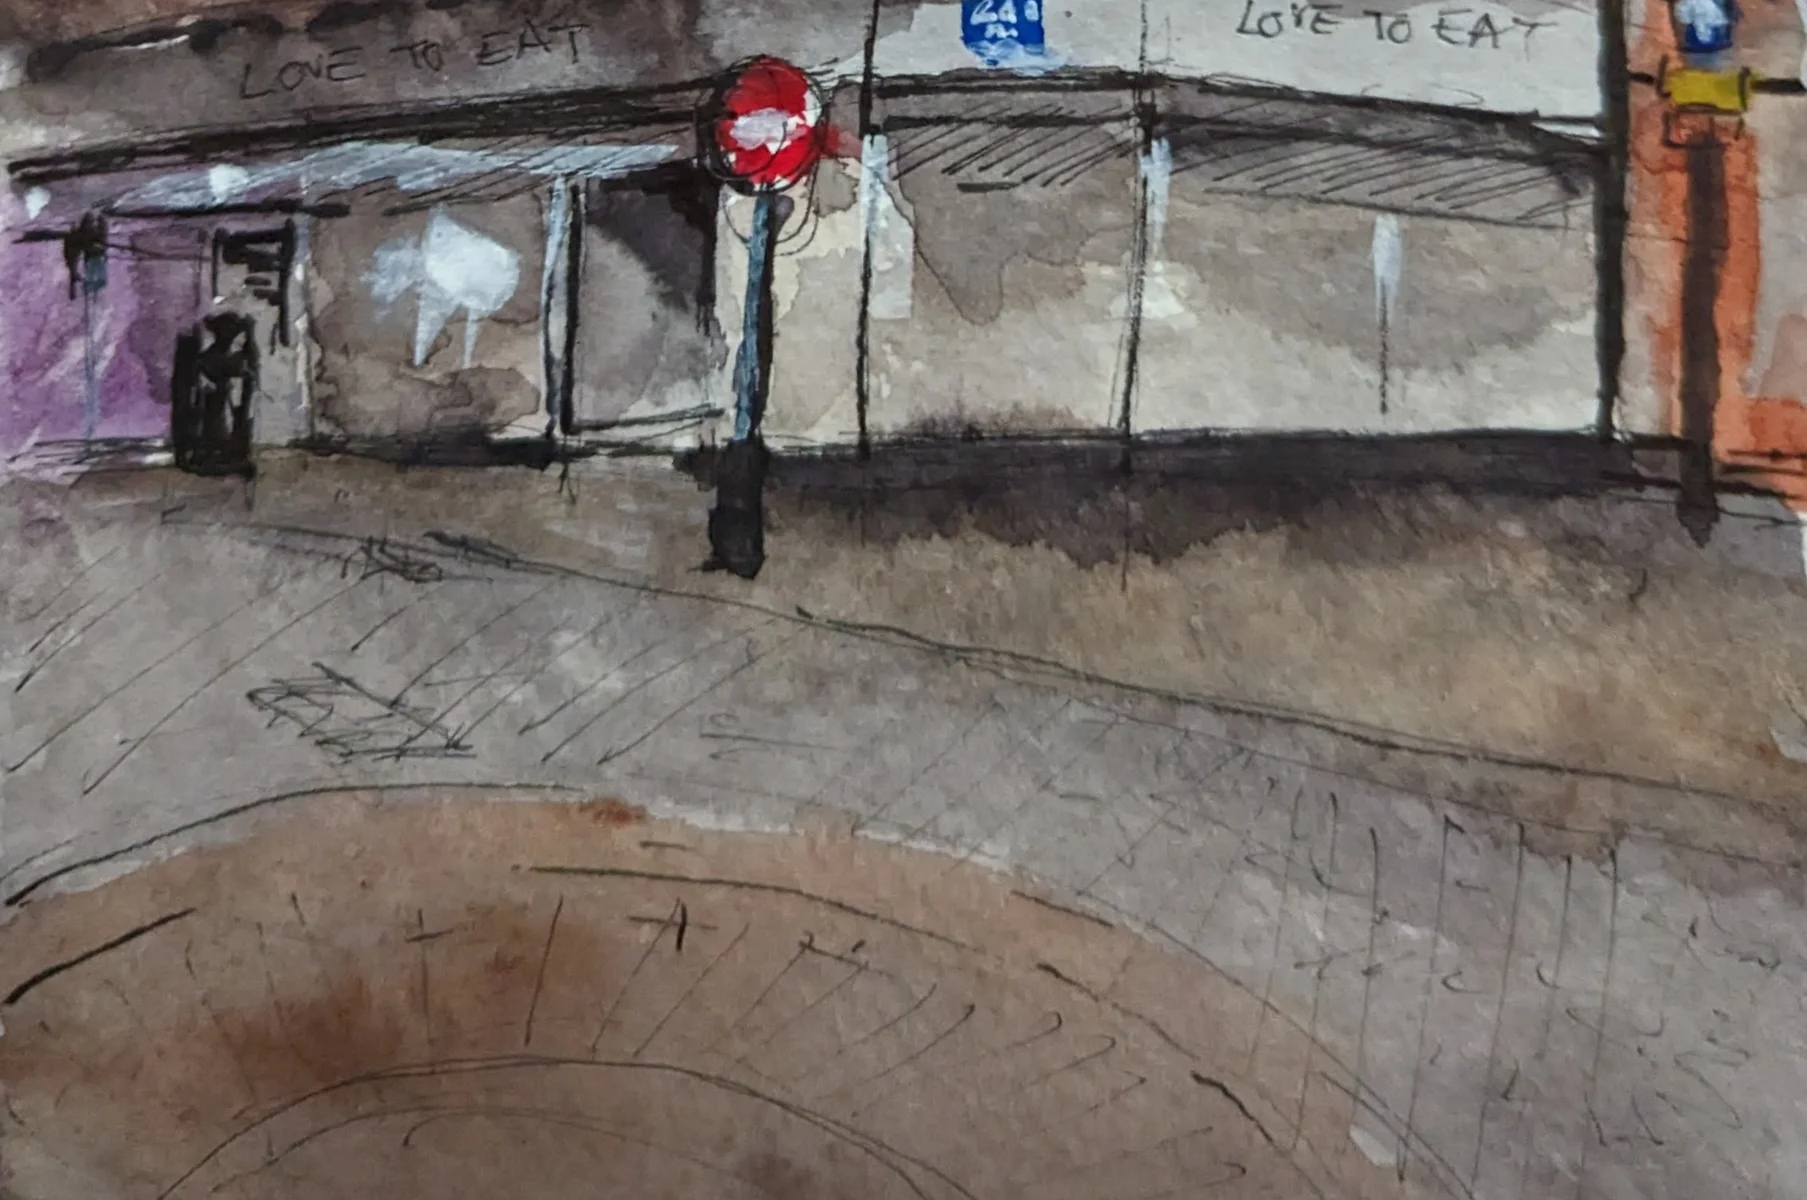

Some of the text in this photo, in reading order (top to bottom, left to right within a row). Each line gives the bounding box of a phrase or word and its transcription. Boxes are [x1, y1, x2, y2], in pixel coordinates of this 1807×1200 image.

[240, 18, 590, 100] LOVE TO EAT
[1362, 9, 1412, 45] TO
[1430, 7, 1559, 62] EAT
